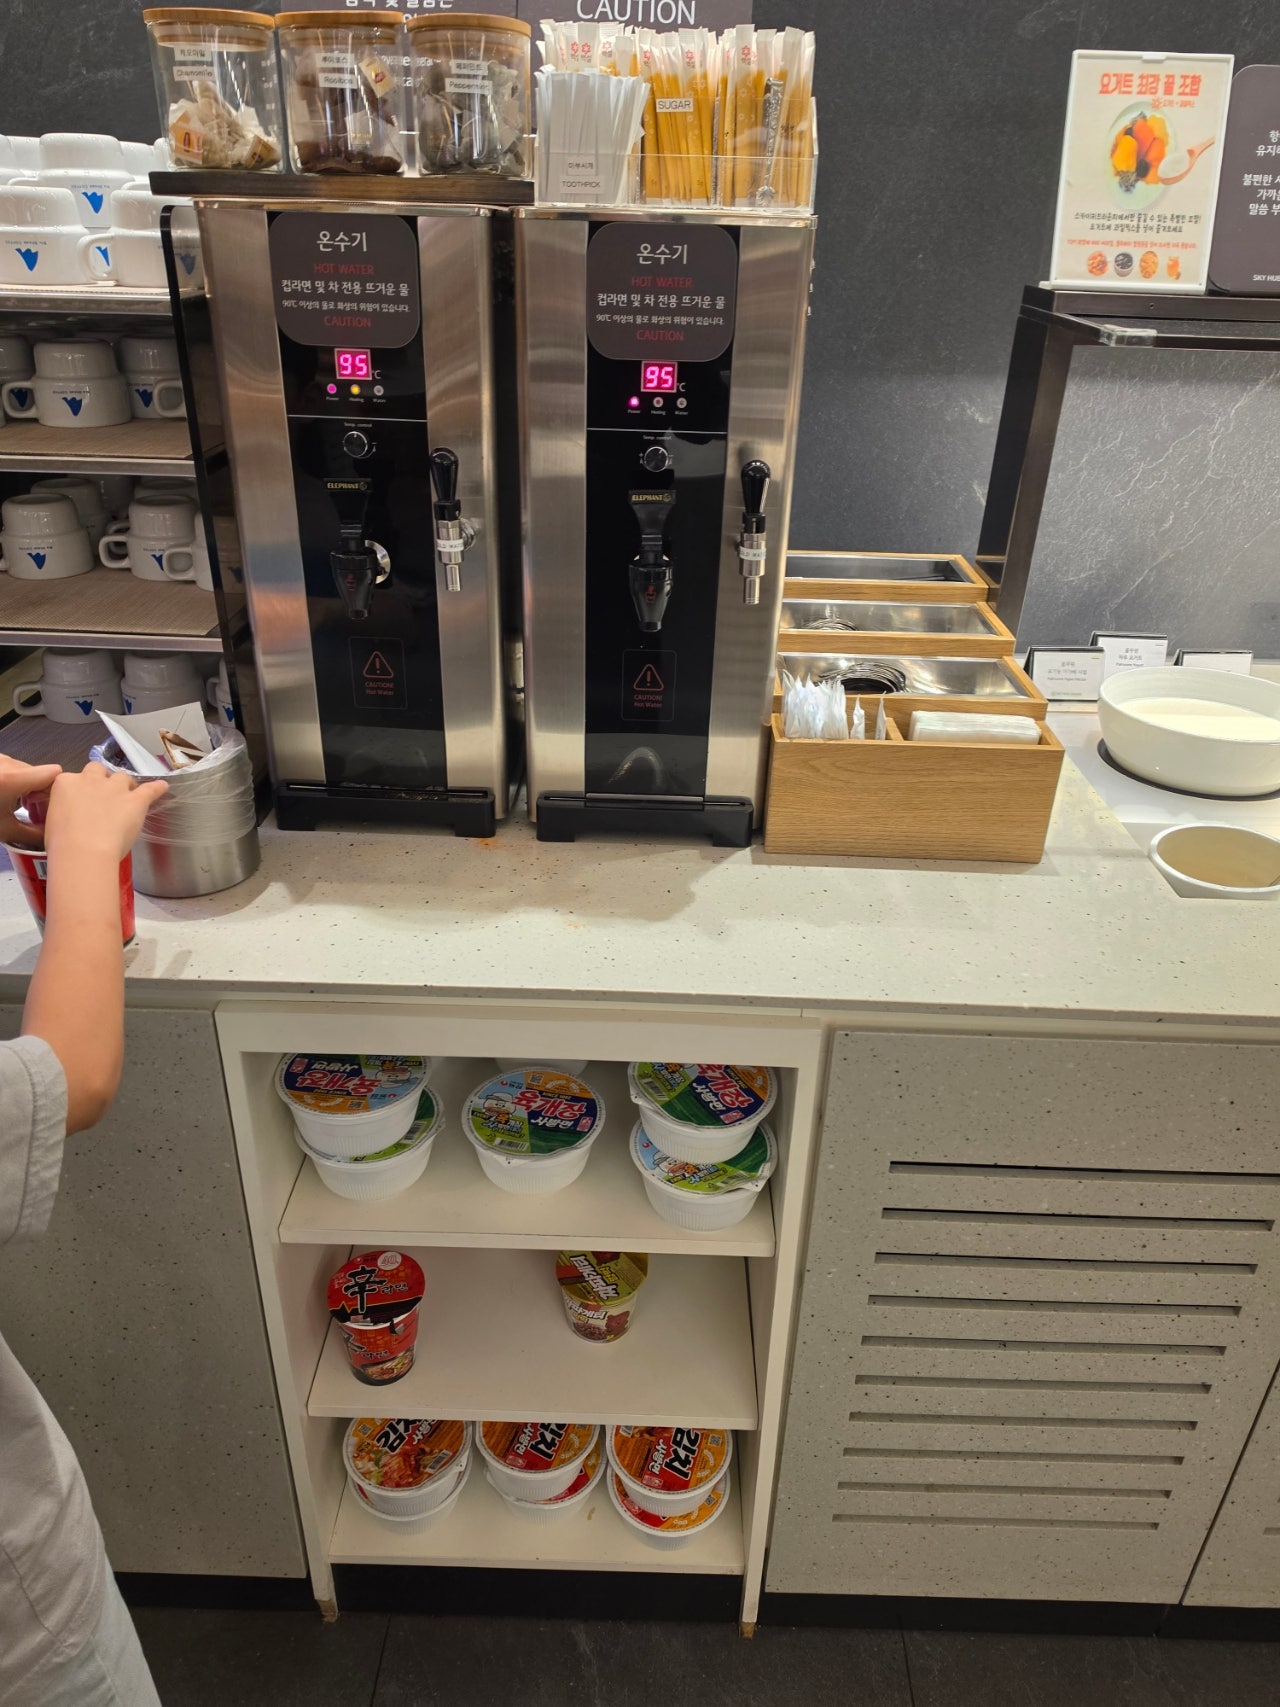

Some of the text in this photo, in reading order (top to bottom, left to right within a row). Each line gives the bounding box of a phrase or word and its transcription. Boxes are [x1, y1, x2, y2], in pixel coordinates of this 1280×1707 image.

[576, 0, 696, 25] CAUTION
[1098, 73, 1134, 94] 요거트
[1137, 73, 1161, 95] 최강
[1177, 74, 1202, 96] 조합
[657, 100, 692, 110] SUGAR
[562, 179, 600, 189] TOOTHPICK
[1242, 174, 1273, 186] 불편한
[1249, 203, 1269, 216] 말씀
[317, 230, 368, 252] 온수기
[636, 243, 688, 265] 온수기
[313, 263, 375, 275] HOT WATER
[281, 279, 410, 297] 컵라면 및 차 전용 뜨거운 물
[631, 276, 693, 288] HOT WATER
[299, 300, 320, 310] 이상의
[321, 301, 335, 310] 물로
[337, 301, 358, 311] 화상의
[359, 302, 380, 312] 위험이
[381, 303, 411, 313] 있습니다.
[597, 293, 726, 310] 컵라면 및 차 전용 뜨거운 물
[323, 316, 372, 328] CAUTION
[612, 314, 634, 324] 이상의
[635, 315, 650, 324] 물로
[650, 315, 672, 325] 화상의
[673, 315, 694, 325] 위험이
[695, 316, 724, 326] 있습니다.
[636, 329, 684, 341] CAUTION
[339, 353, 368, 376] 95
[645, 366, 674, 388] 95
[327, 481, 359, 490] ELEPHANT
[631, 494, 664, 502] ELEPHANT
[633, 693, 663, 701] CAUTION!
[311, 1060, 360, 1072] 사발면
[296, 1070, 383, 1096] 육개장
[510, 1089, 588, 1119] 육개장
[692, 1082, 727, 1113] 사발면
[529, 1116, 574, 1130] 사발면
[569, 1254, 620, 1301] 짜파게티
[343, 1265, 387, 1314] 辛
[649, 1438, 670, 1475] 사발면
[663, 1427, 702, 1480] 김치
